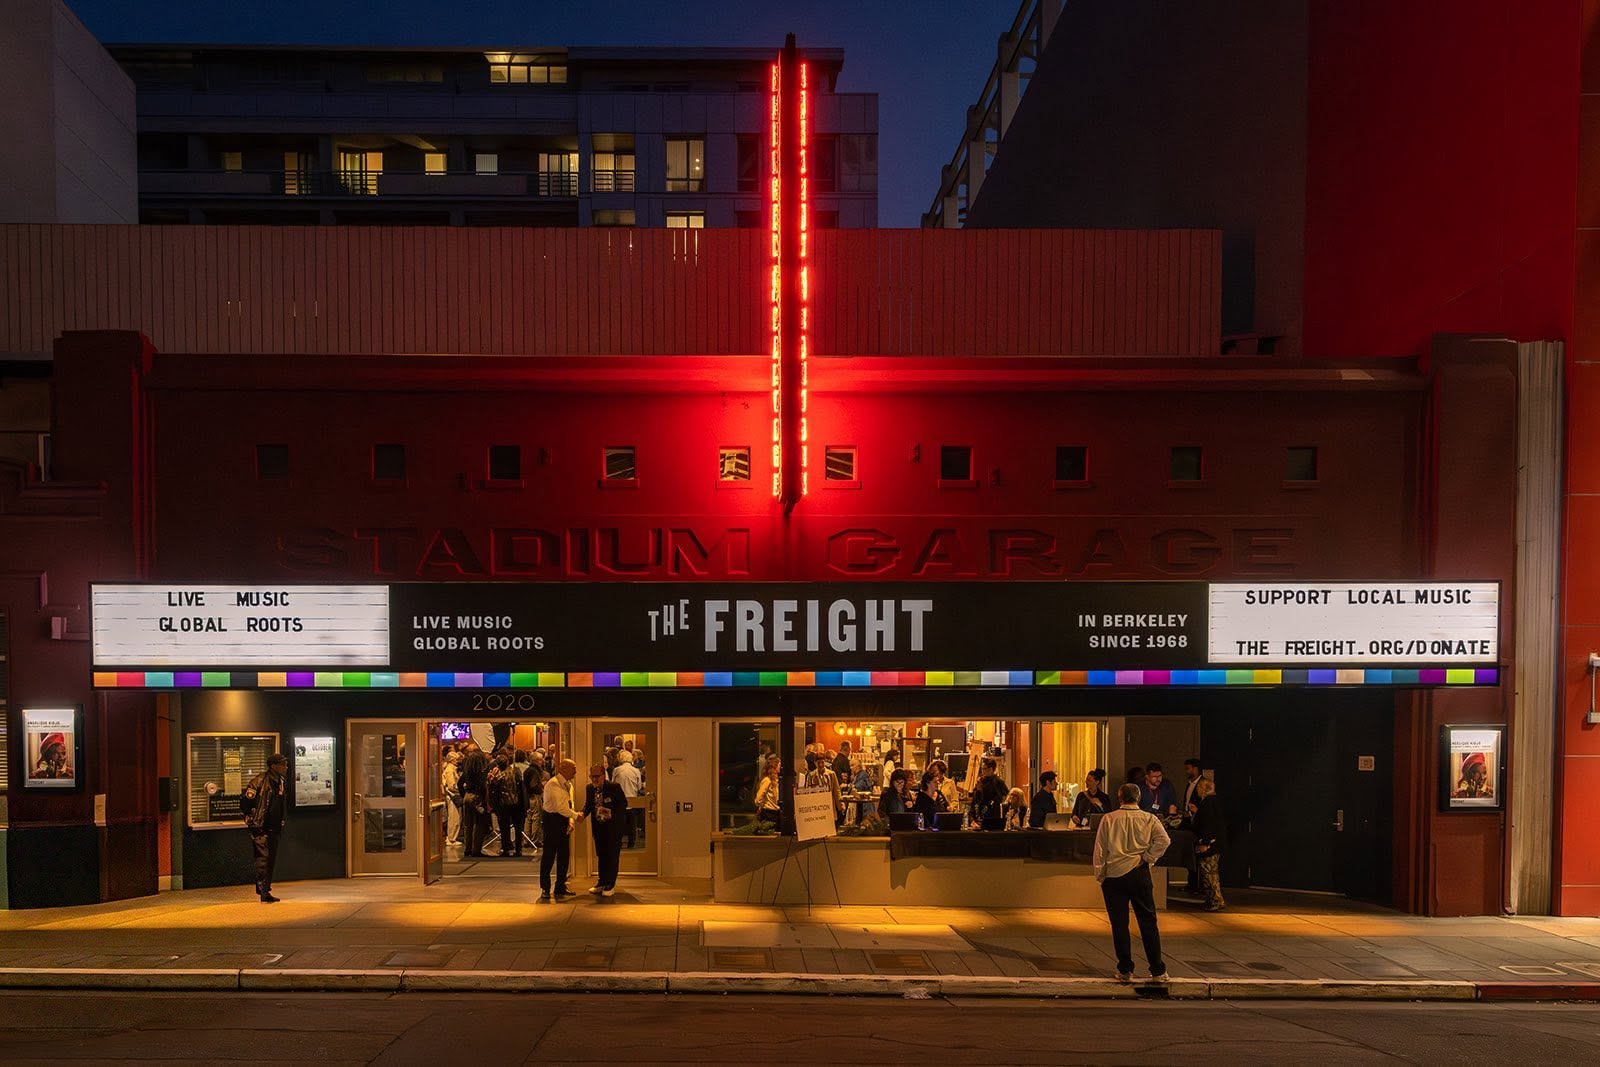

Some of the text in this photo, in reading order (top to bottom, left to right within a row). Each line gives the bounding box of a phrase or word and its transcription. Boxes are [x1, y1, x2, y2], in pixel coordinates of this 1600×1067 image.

[277, 527, 1297, 577] STADIUM GARAGE
[168, 592, 290, 607] LIVE MUSIC
[1245, 589, 1472, 605] SUPPORT LOCAL MUSIC
[159, 616, 303, 633] GLOBAL ROOTS
[413, 615, 513, 629] LIVE MUSIC
[648, 599, 933, 652] THE FREIGHT
[1078, 614, 1188, 628] IN BERKELEY
[413, 636, 544, 650] GLOBAL ROOTS
[1089, 635, 1188, 648] SINCE 1968
[1236, 640, 1270, 656] THE
[473, 694, 535, 711] 2020
[799, 805, 830, 813] REGISTRATION
